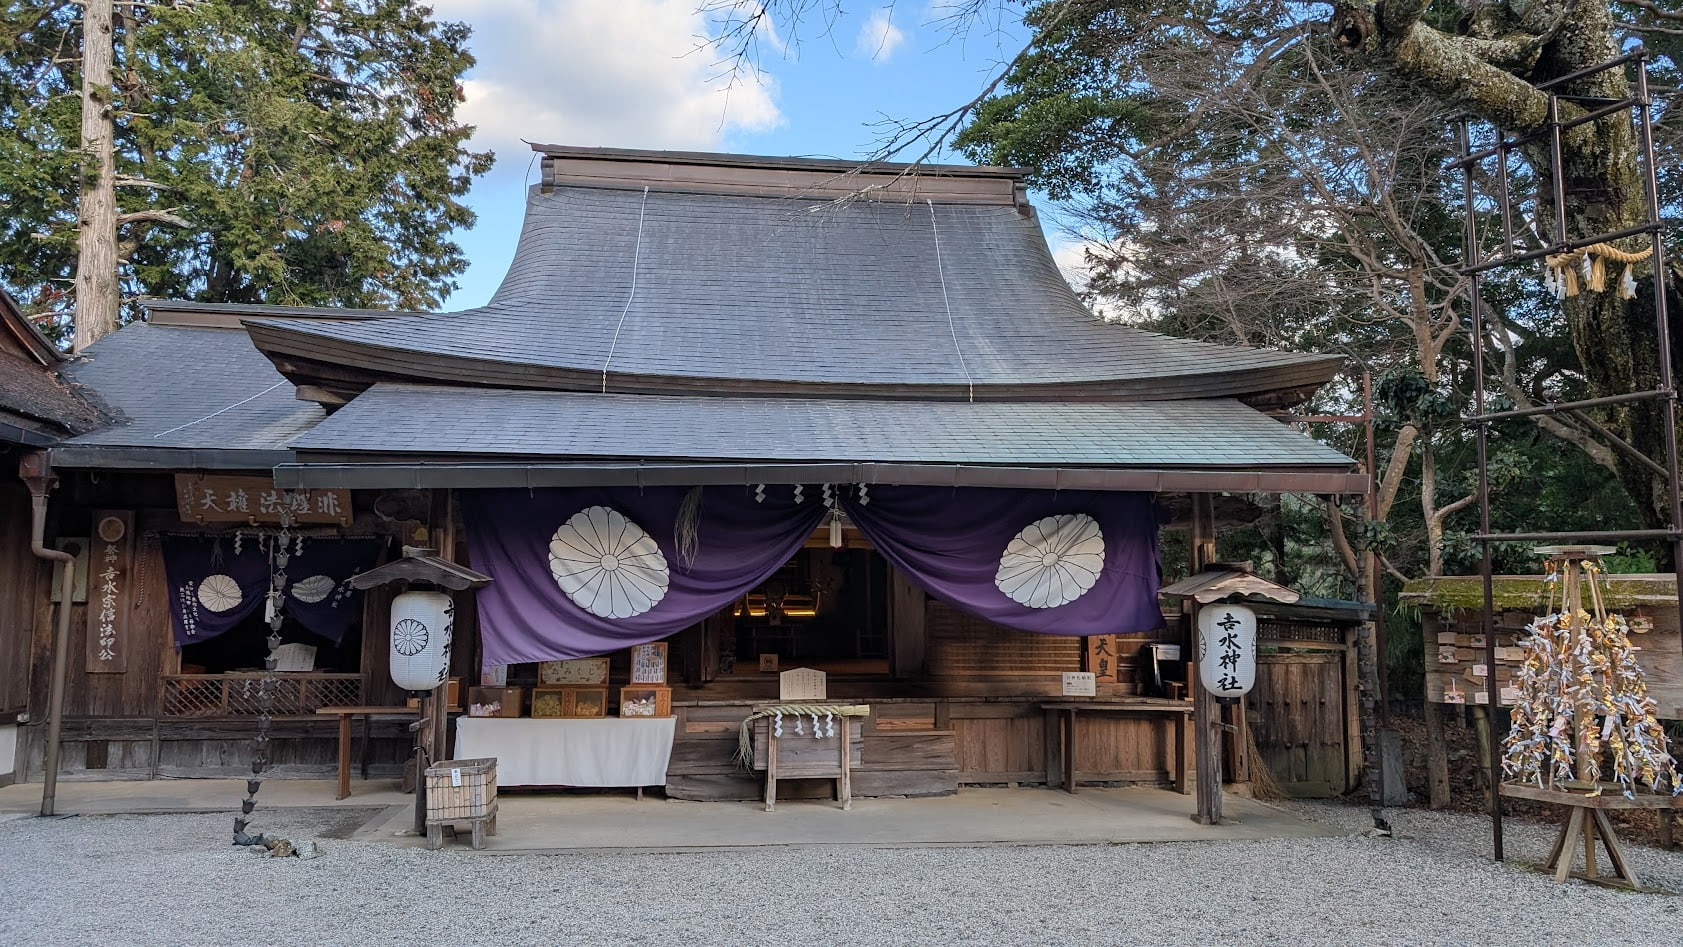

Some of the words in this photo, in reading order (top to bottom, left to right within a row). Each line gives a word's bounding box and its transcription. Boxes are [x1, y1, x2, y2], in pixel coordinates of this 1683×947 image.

[1095, 638, 1113, 678] 天皇
[1217, 612, 1243, 691] 吉水神社
[552, 668, 594, 676] おみくじ
